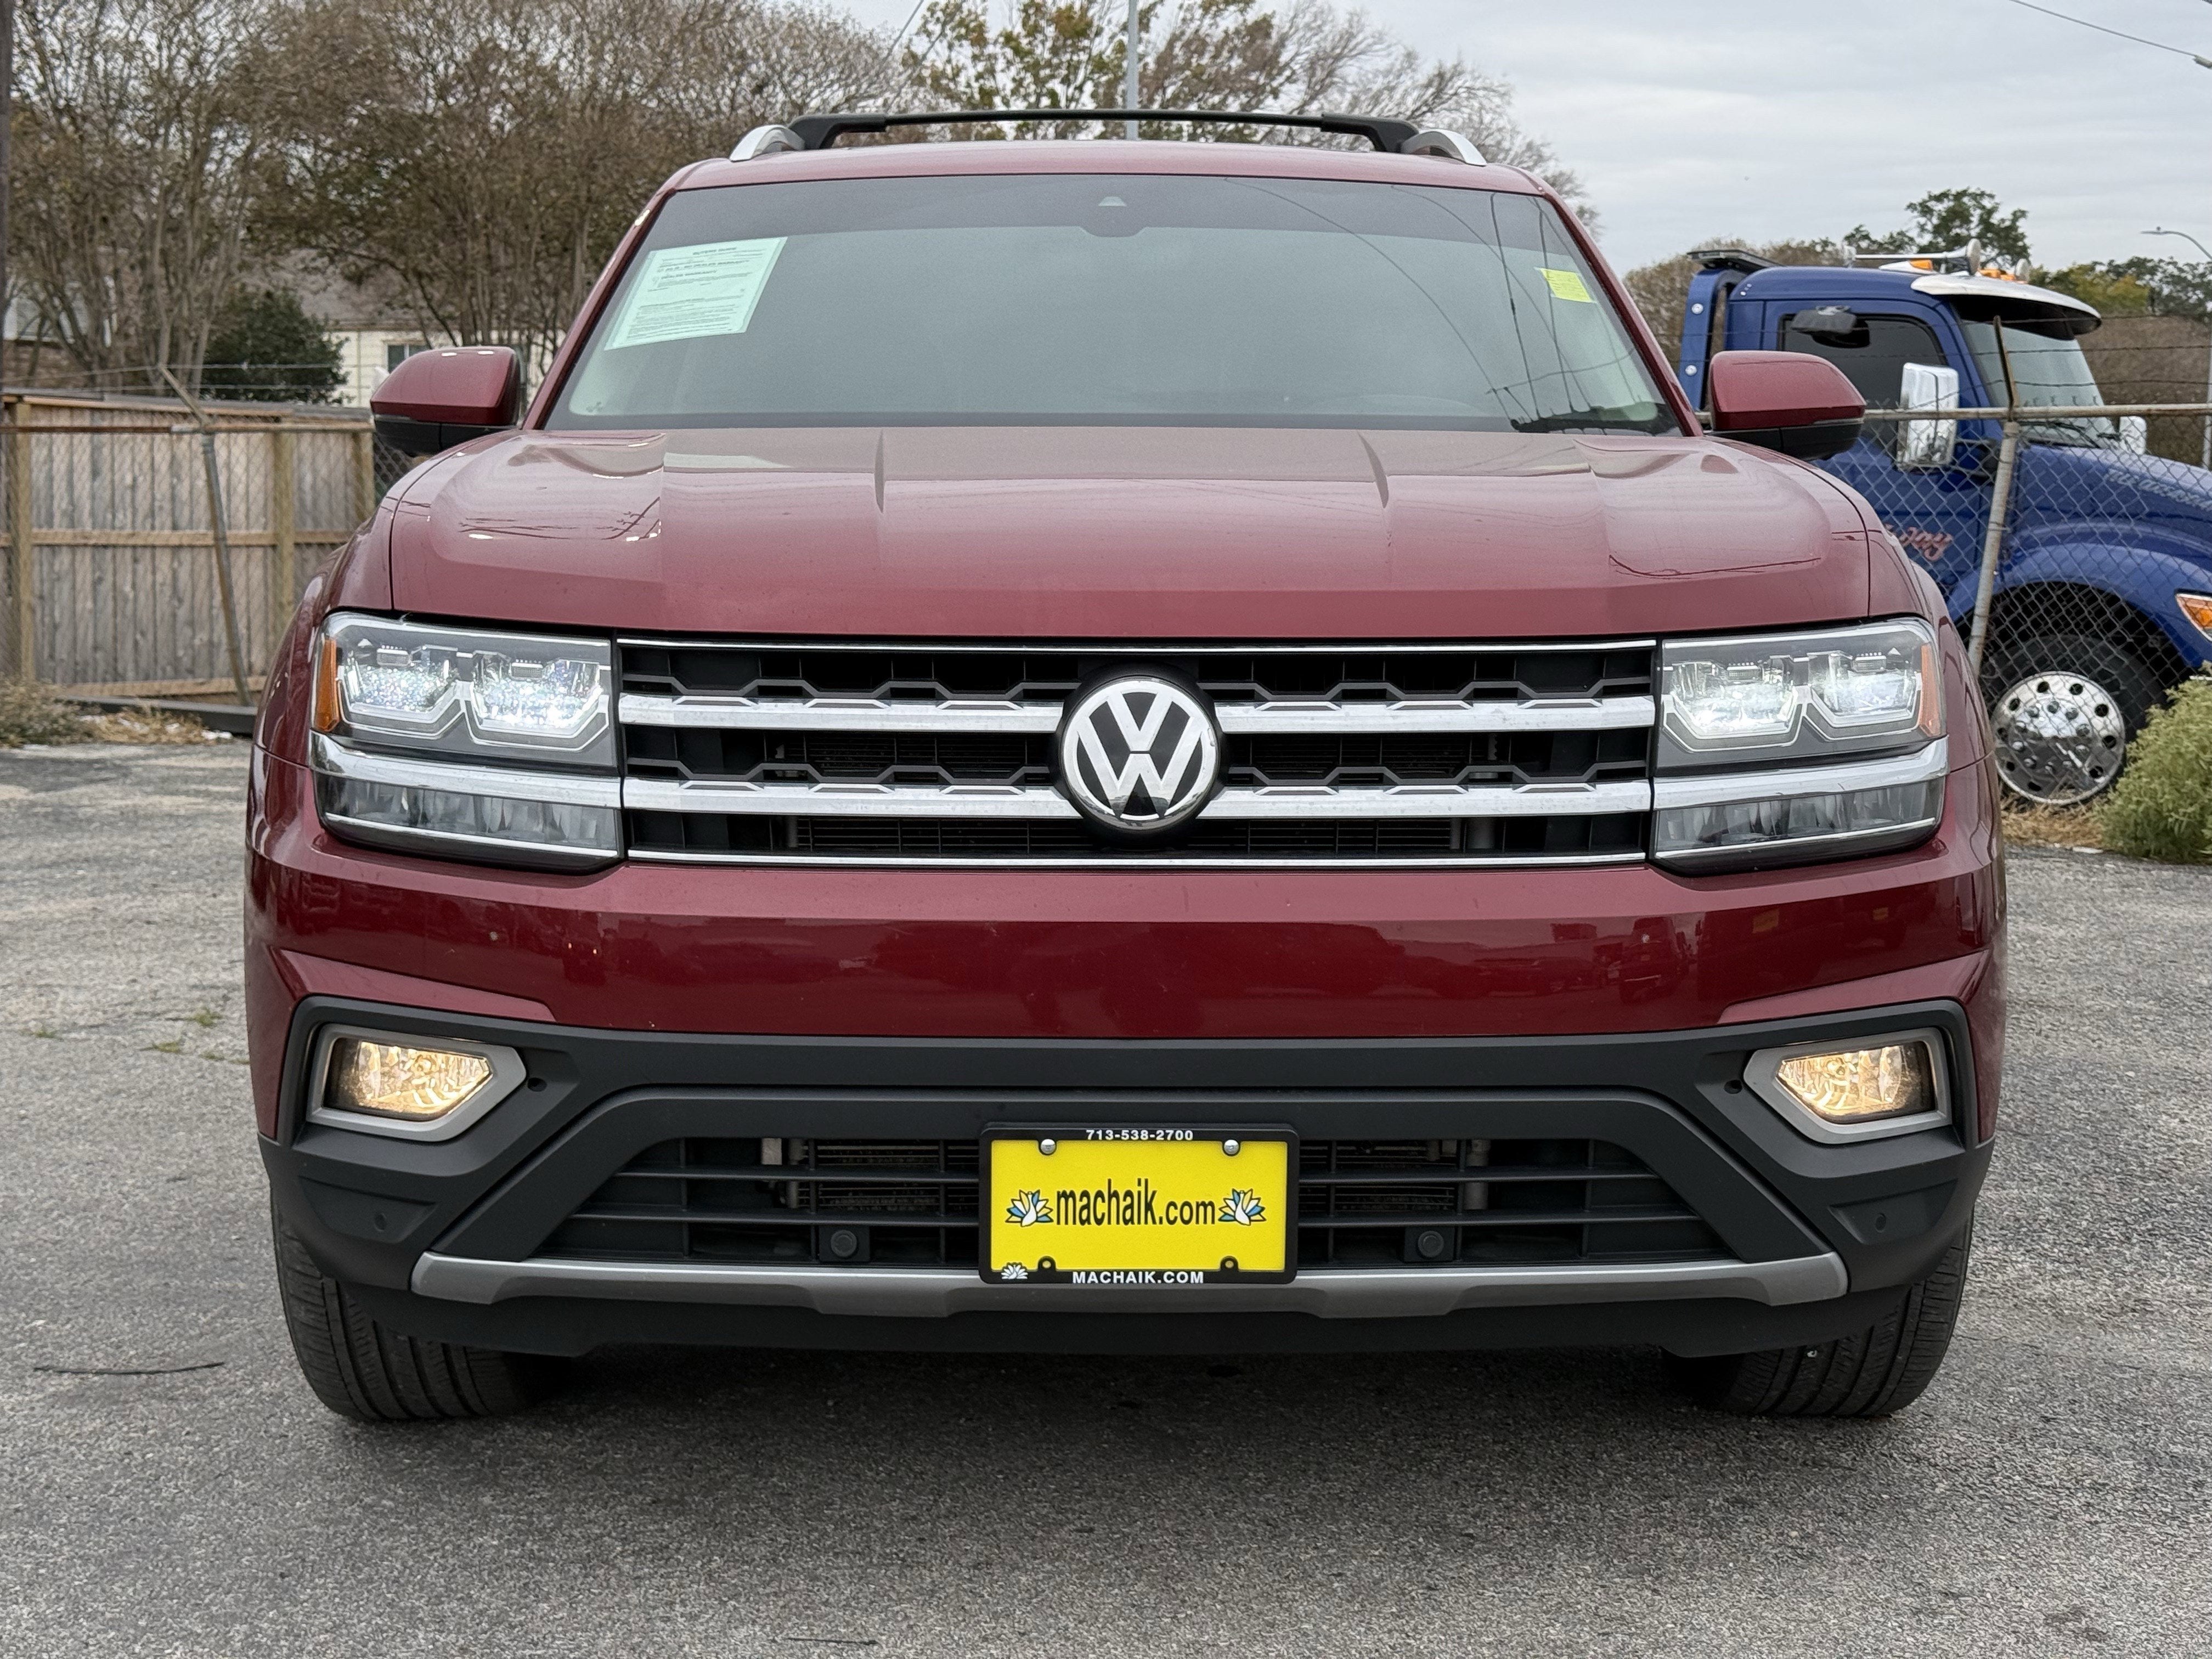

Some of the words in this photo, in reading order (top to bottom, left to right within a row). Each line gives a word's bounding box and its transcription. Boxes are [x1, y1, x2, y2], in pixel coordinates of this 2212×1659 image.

[1070, 684, 1210, 821] VW
[1086, 1130, 1193, 1141] 713-538-2700
[1057, 1178, 1215, 1226] machaik.com
[1073, 1272, 1204, 1284] MACHAIK.COM
